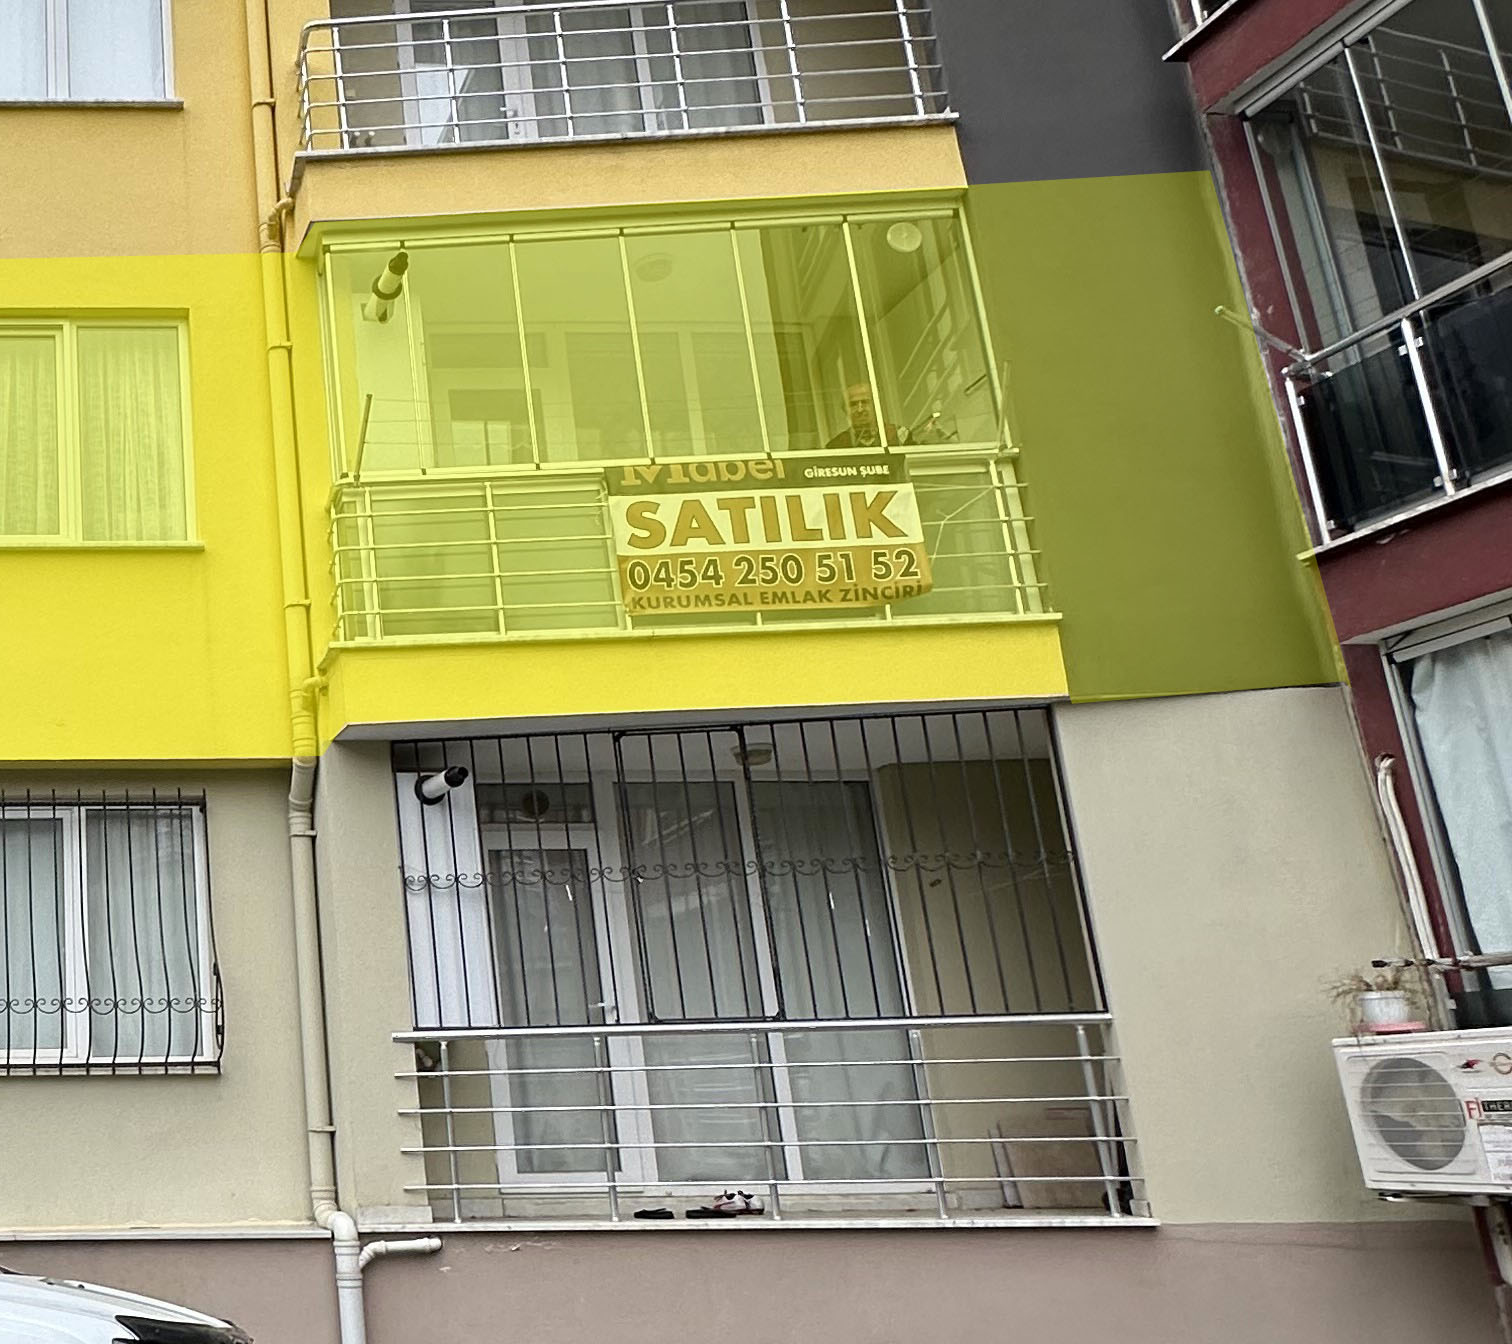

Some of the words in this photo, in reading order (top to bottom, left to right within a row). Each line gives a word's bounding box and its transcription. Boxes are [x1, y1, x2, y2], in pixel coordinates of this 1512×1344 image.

[804, 465, 858, 479] GİRESUN
[859, 464, 890, 479] ŞUBE
[626, 490, 909, 550] SATILIK
[627, 557, 725, 592] 0454
[733, 553, 806, 586] 250
[815, 552, 855, 583] 51
[872, 548, 922, 581] 52
[632, 591, 755, 611] KURUMSAL
[759, 588, 833, 605] EMLAK
[839, 582, 923, 603] ZİNCİRİ
